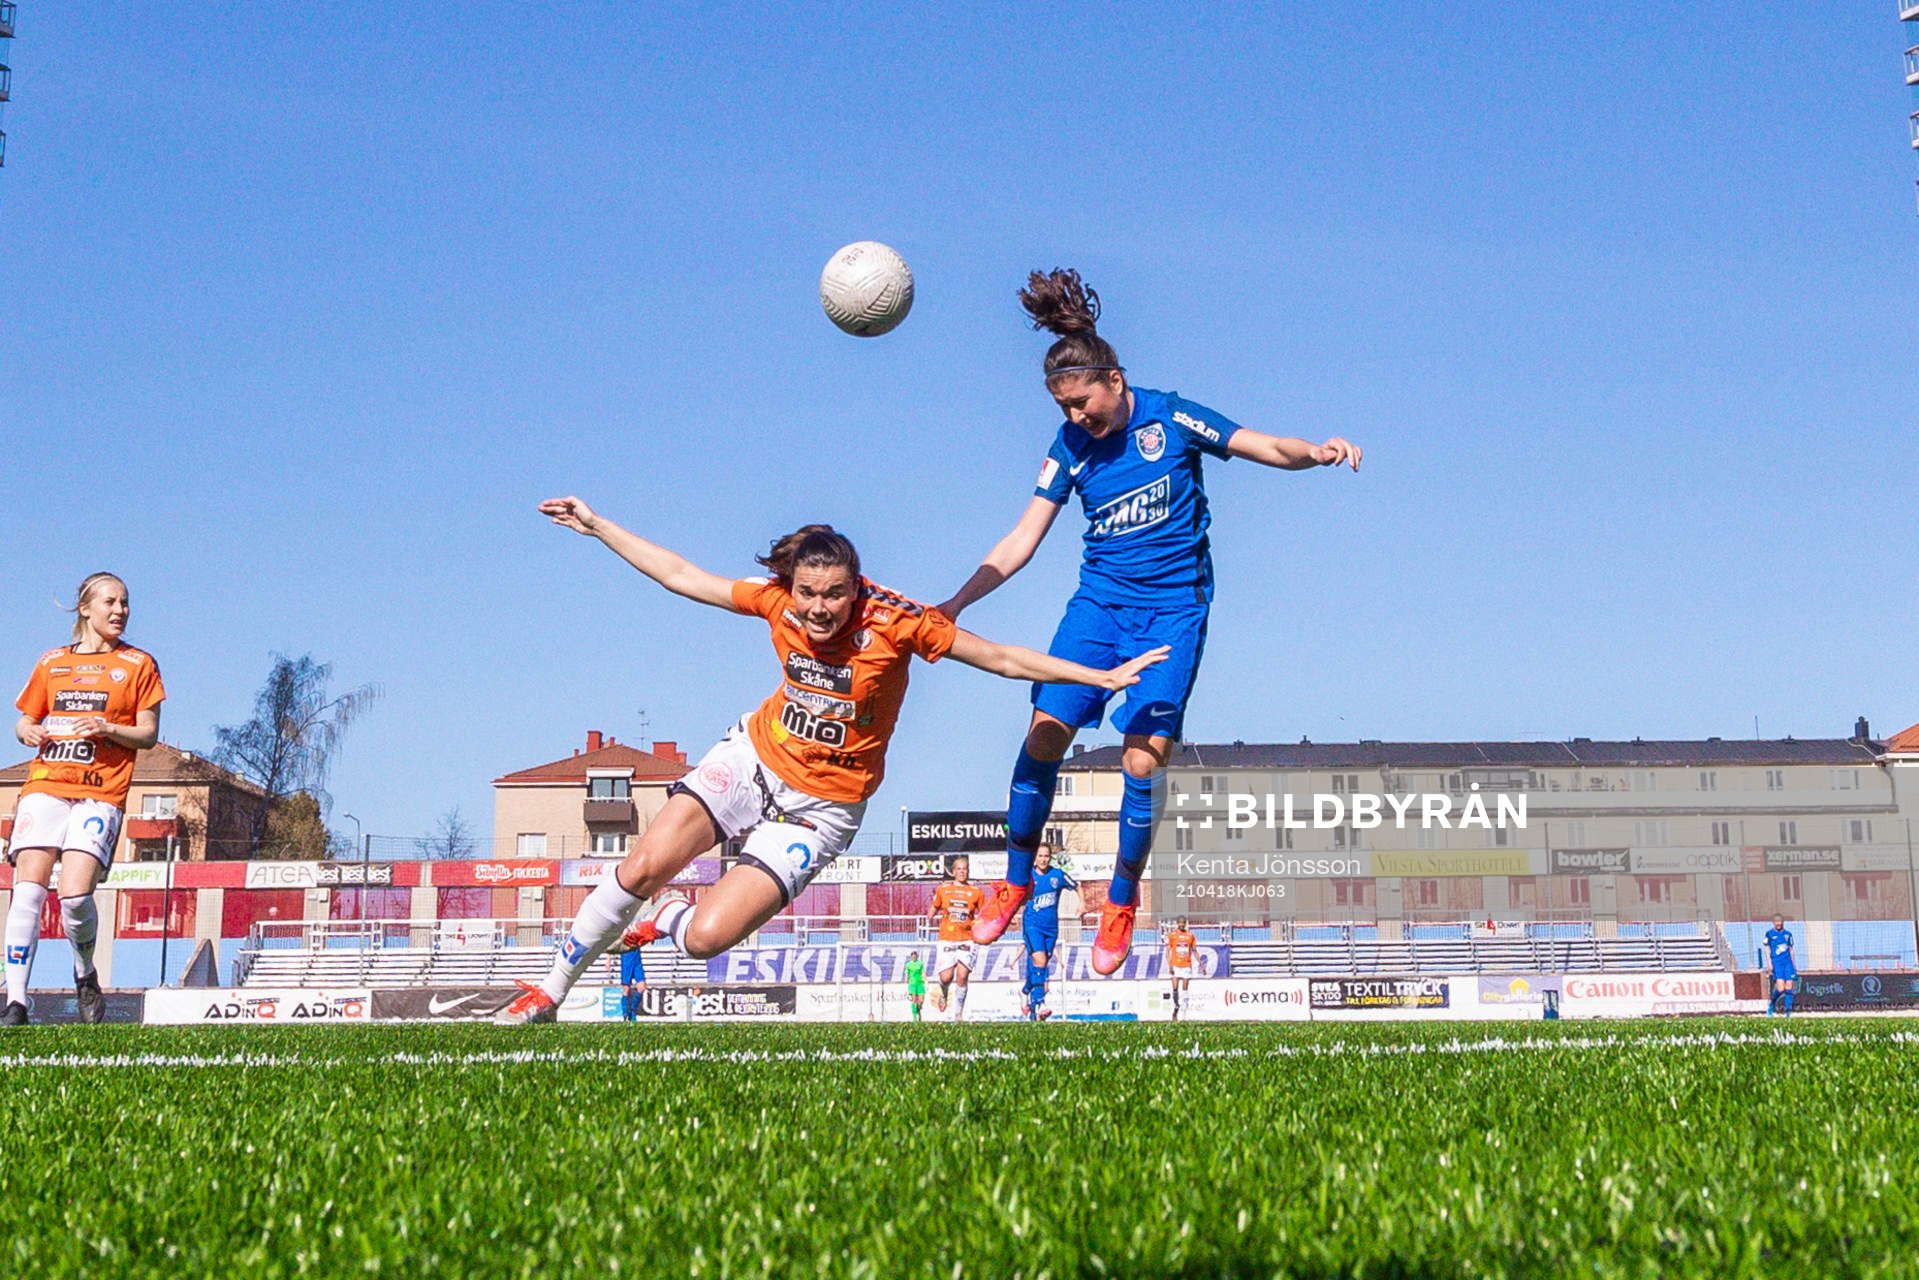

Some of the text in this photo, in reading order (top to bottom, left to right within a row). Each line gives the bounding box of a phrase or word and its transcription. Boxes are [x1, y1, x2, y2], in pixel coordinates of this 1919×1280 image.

[1172, 411, 1220, 442] stadium
[1149, 483, 1165, 503] 20
[1148, 503, 1164, 521] 30
[788, 652, 852, 679] Sparbanken
[800, 671, 834, 690] Skåne
[56, 690, 108, 702] Sparbanken
[65, 701, 94, 712] Skåne
[911, 824, 1005, 839] ESKILSTUNA
[1239, 991, 1289, 1004] exma
[1566, 979, 1731, 998] Canon Canon
